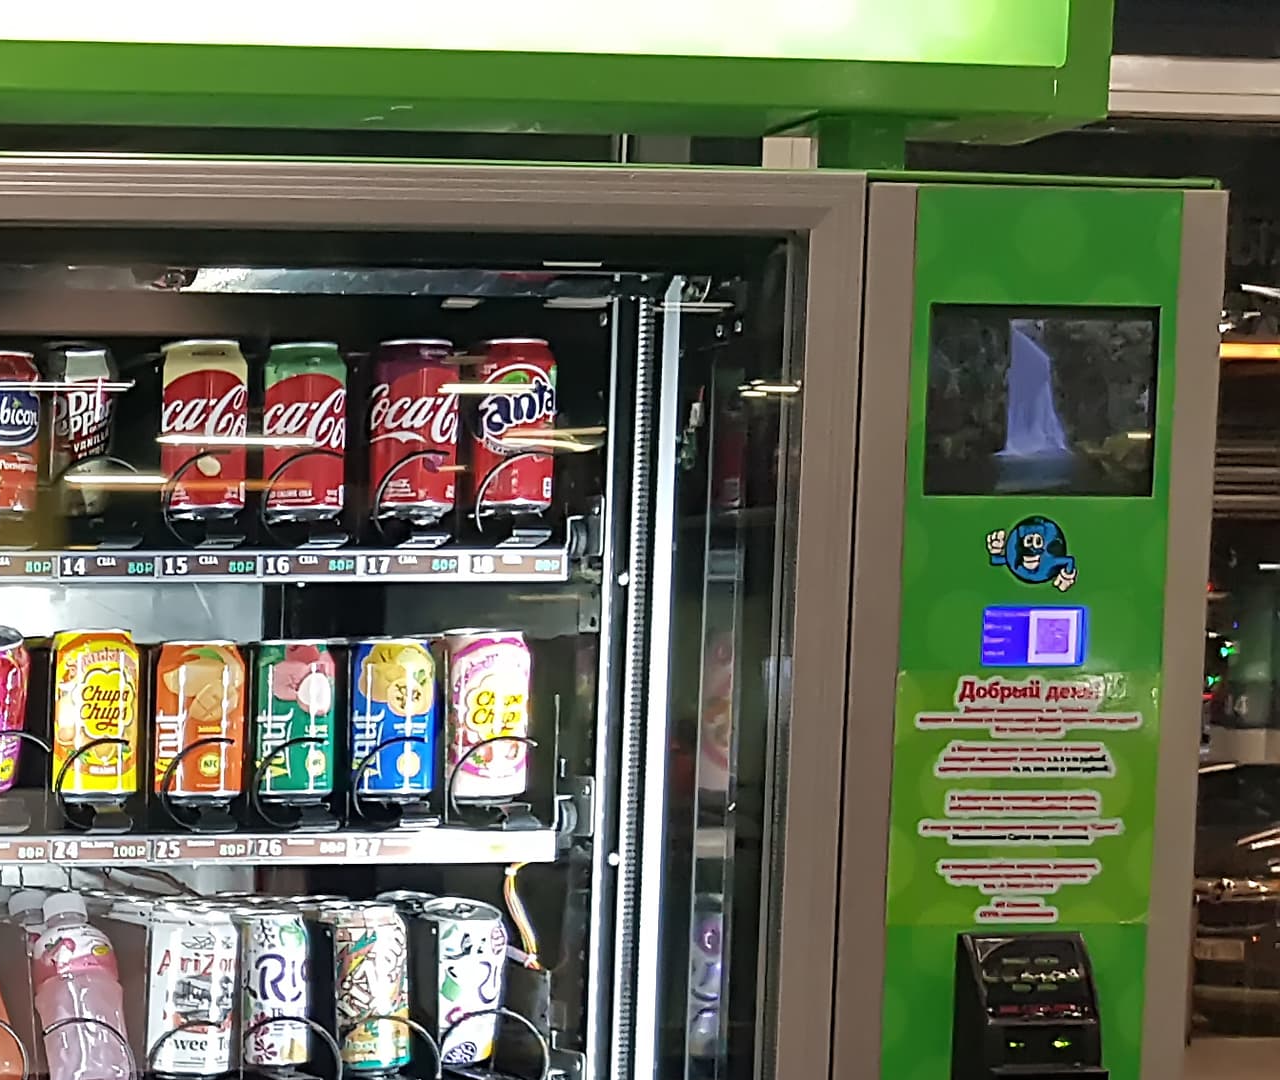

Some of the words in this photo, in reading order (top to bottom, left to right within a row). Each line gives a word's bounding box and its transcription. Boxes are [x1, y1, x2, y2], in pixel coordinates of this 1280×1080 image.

[63, 557, 86, 576] 14
[165, 556, 188, 574] 15
[266, 556, 290, 574] 16
[367, 556, 390, 574] 17
[81, 684, 129, 705] Chupa
[958, 680, 1041, 703] Добрый
[79, 703, 129, 725] Chups
[53, 842, 78, 859] 24
[157, 841, 180, 858] 25
